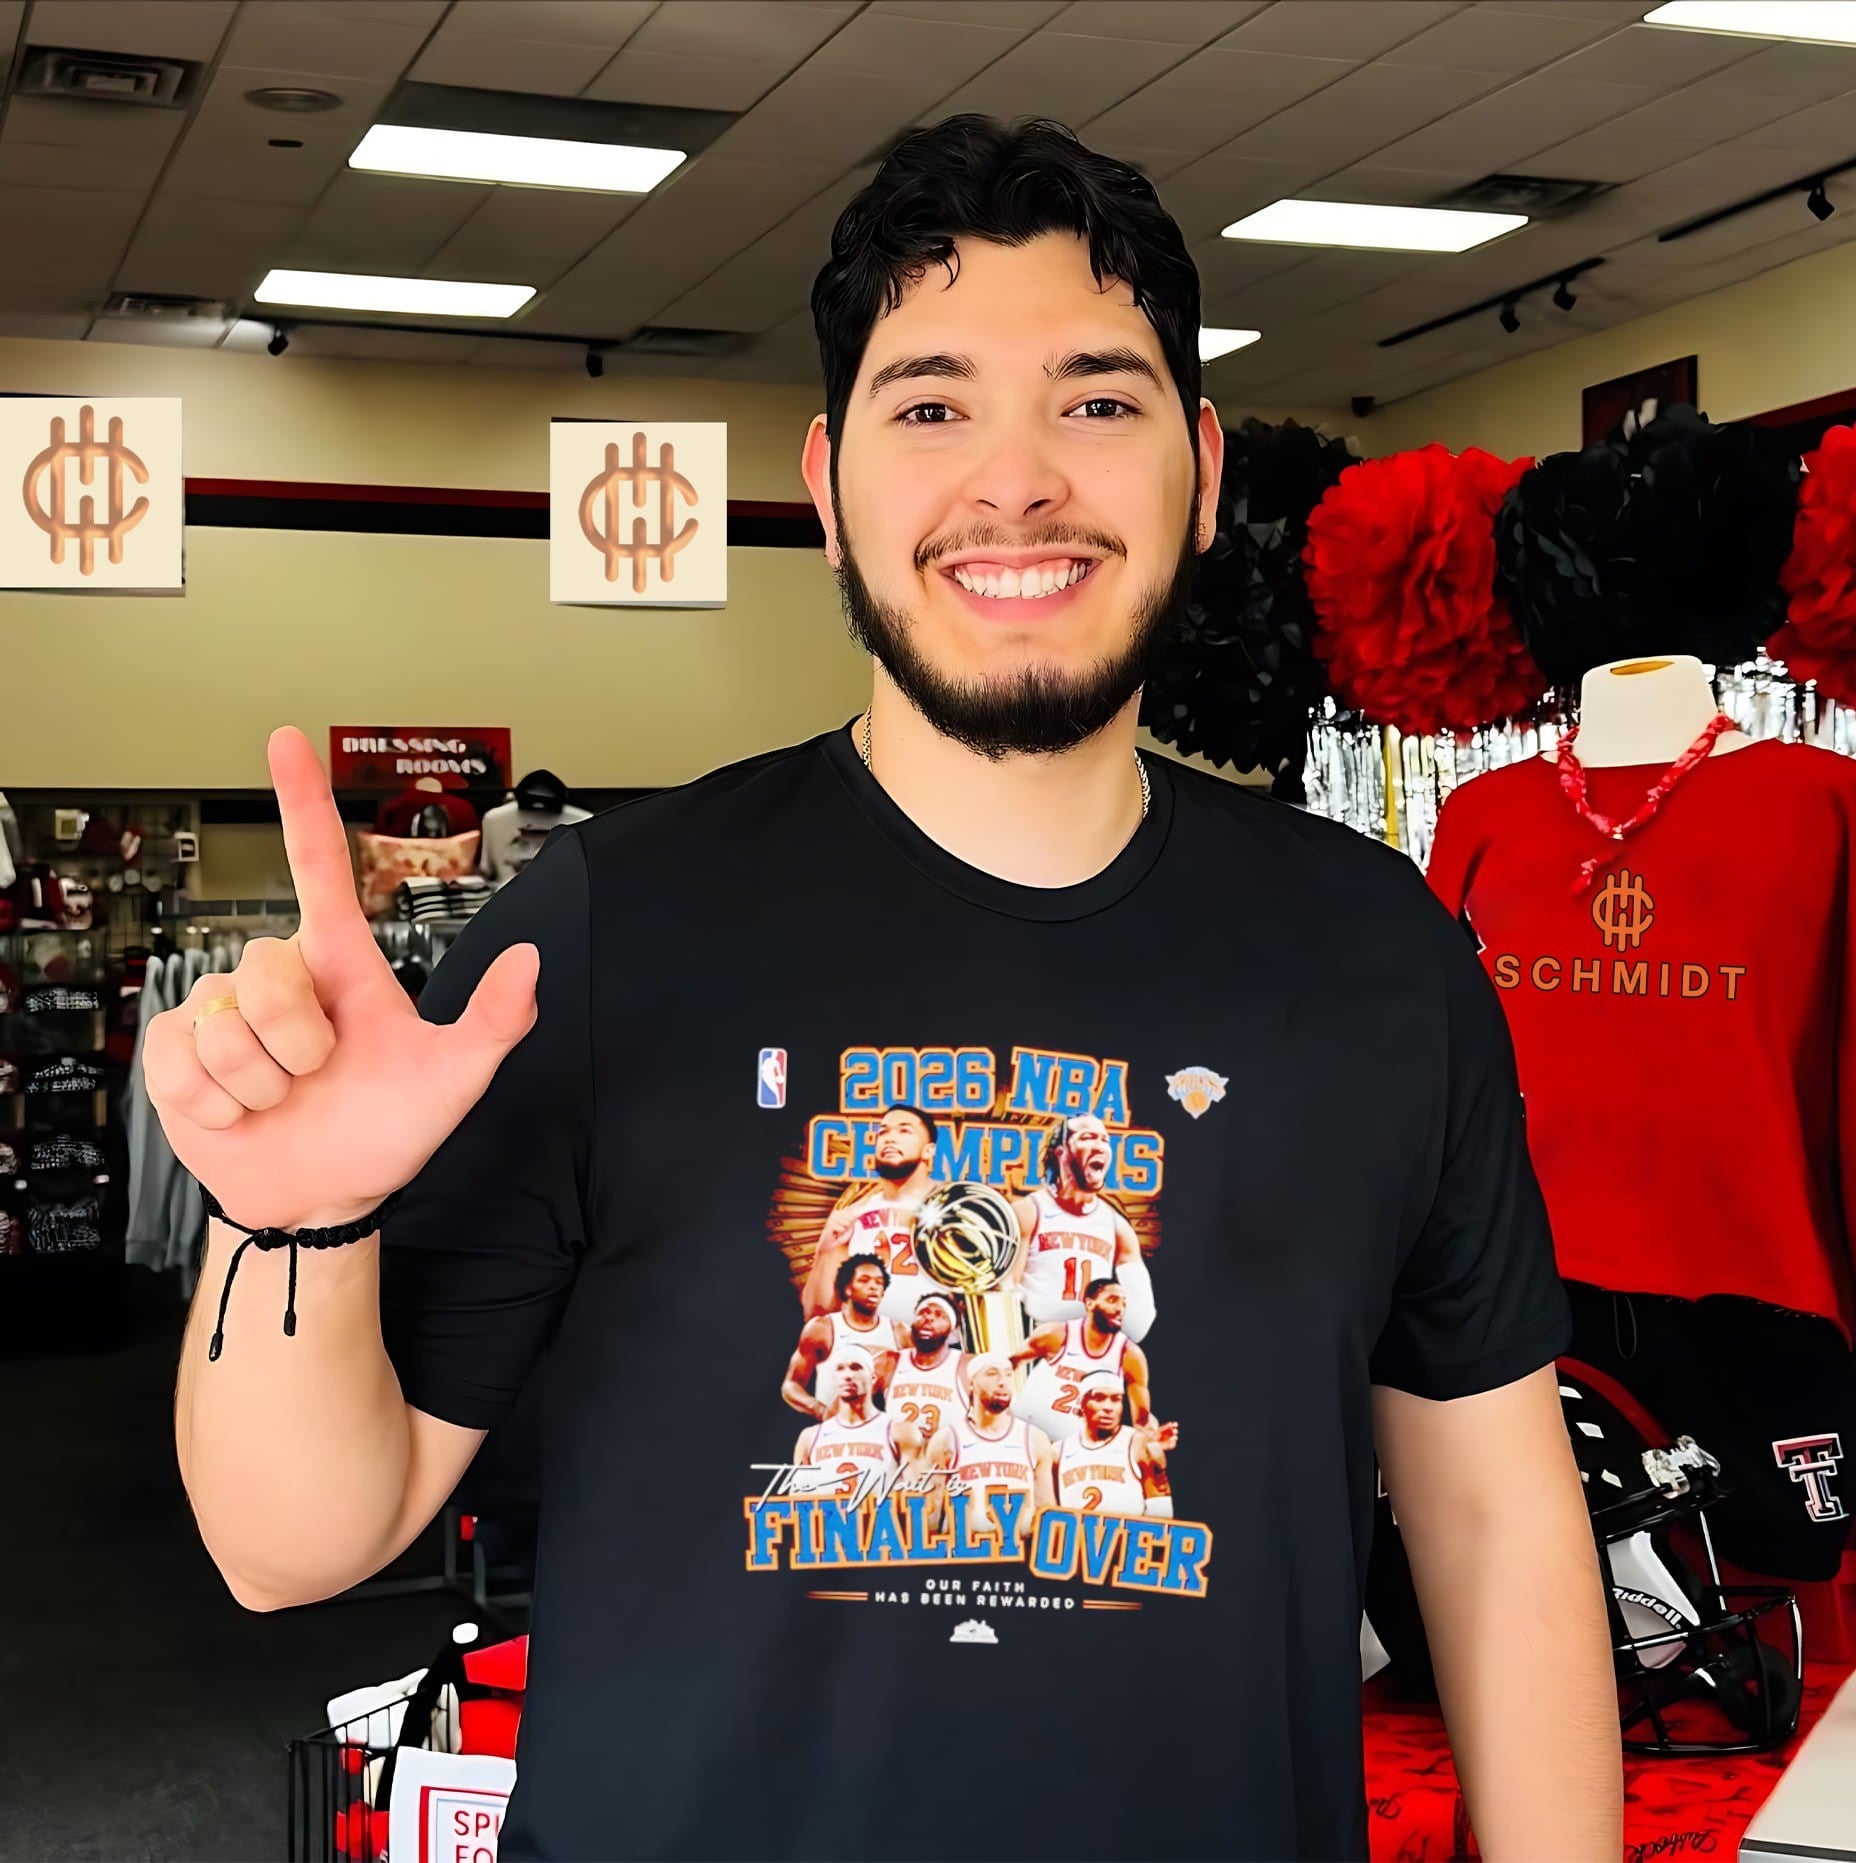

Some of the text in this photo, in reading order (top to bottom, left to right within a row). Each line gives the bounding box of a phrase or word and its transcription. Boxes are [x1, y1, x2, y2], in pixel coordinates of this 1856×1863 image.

[1494, 954, 1747, 999] SCHMIDT
[839, 1046, 1132, 1128] 2026 NBA
[808, 1114, 1165, 1197] CHMPIS
[750, 1463, 821, 1511] The
[847, 1462, 959, 1513] Wait
[744, 1484, 1214, 1598] FINALLY OVER
[875, 1591, 1075, 1610] HAS BEEN REWARDED
[925, 1579, 1026, 1593] OUR FAITH
